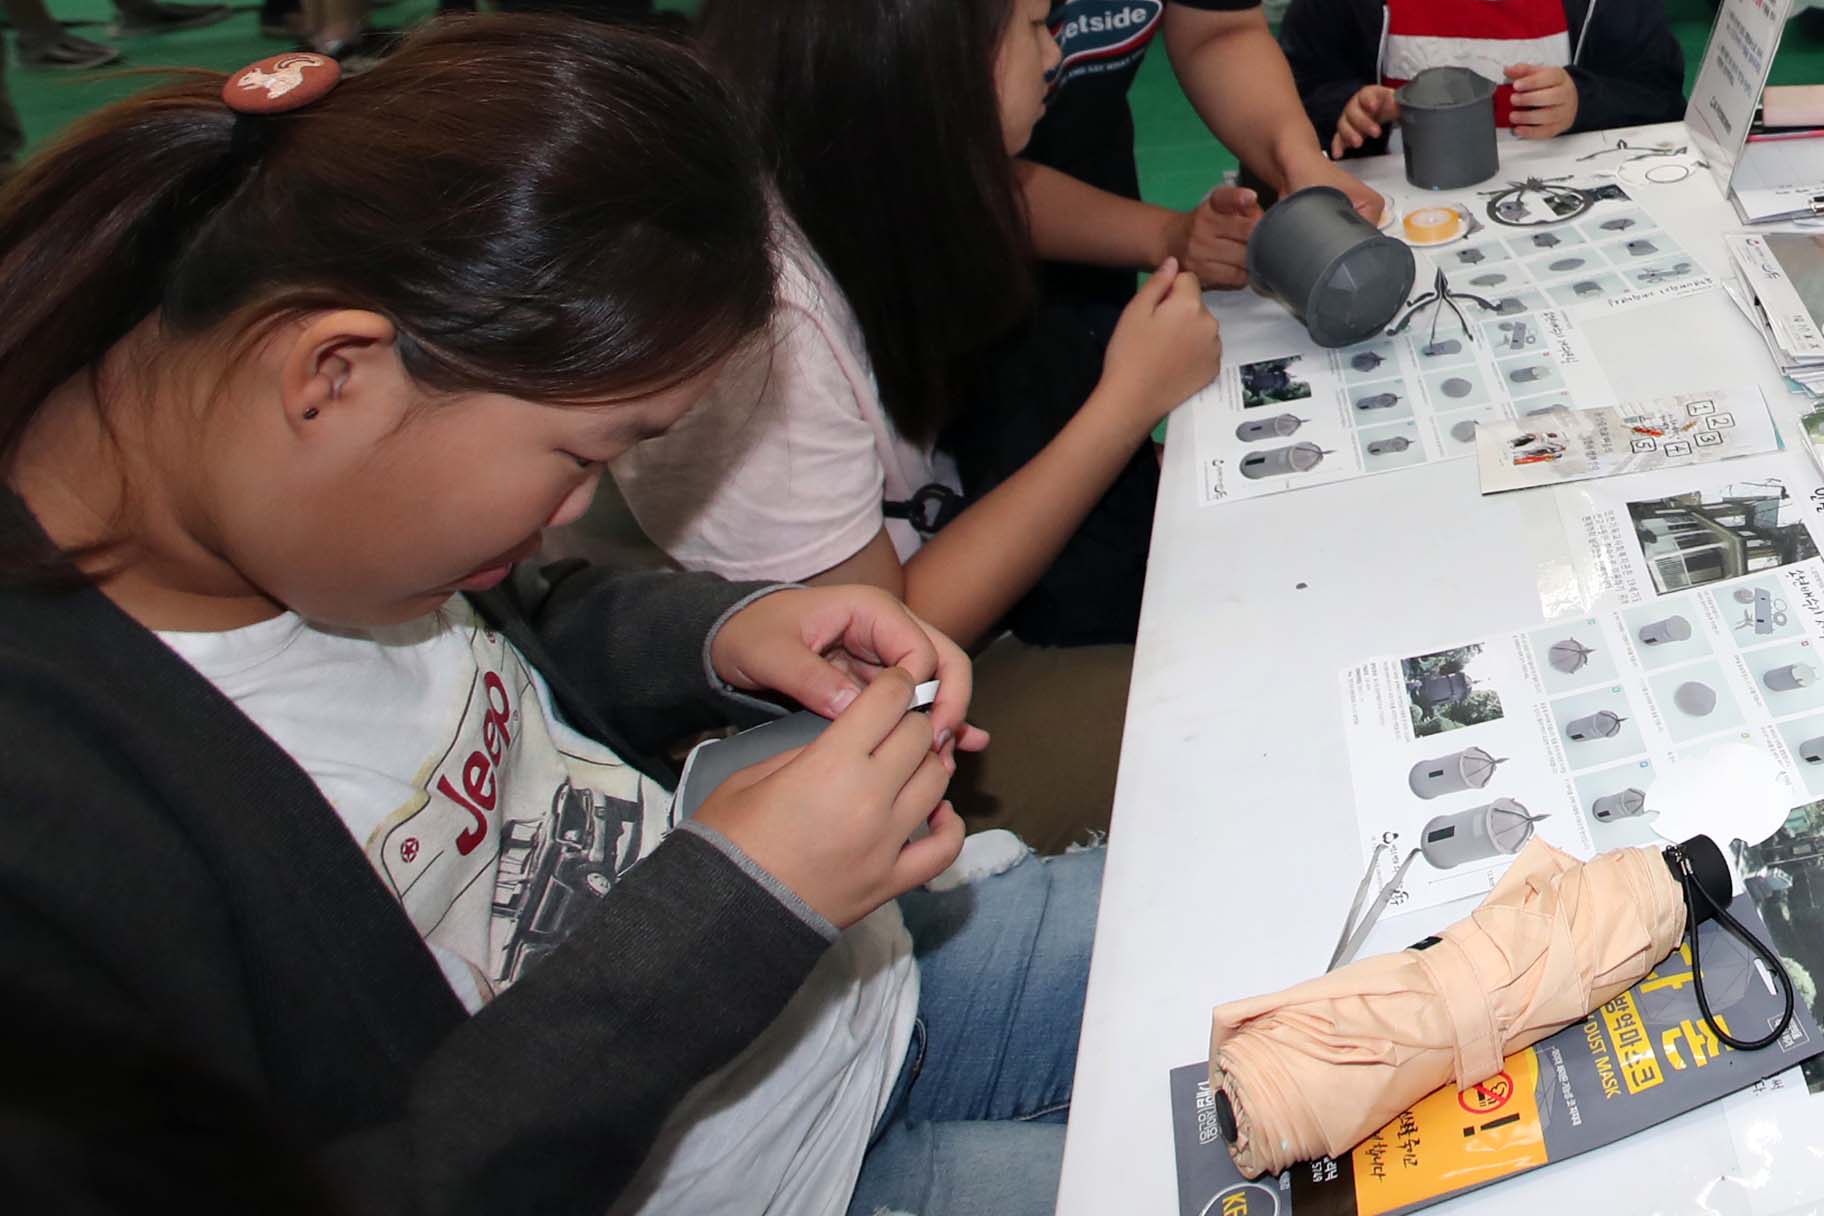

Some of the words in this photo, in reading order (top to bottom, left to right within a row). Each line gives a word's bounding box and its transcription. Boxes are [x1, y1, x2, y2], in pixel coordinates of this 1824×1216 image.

[1061, 7, 1147, 40] etside
[438, 671, 511, 856] Jeep
[1584, 1021, 1607, 1054] DUST
[1605, 995, 1656, 1087] 방역마스크
[1594, 1056, 1621, 1100] MASK
